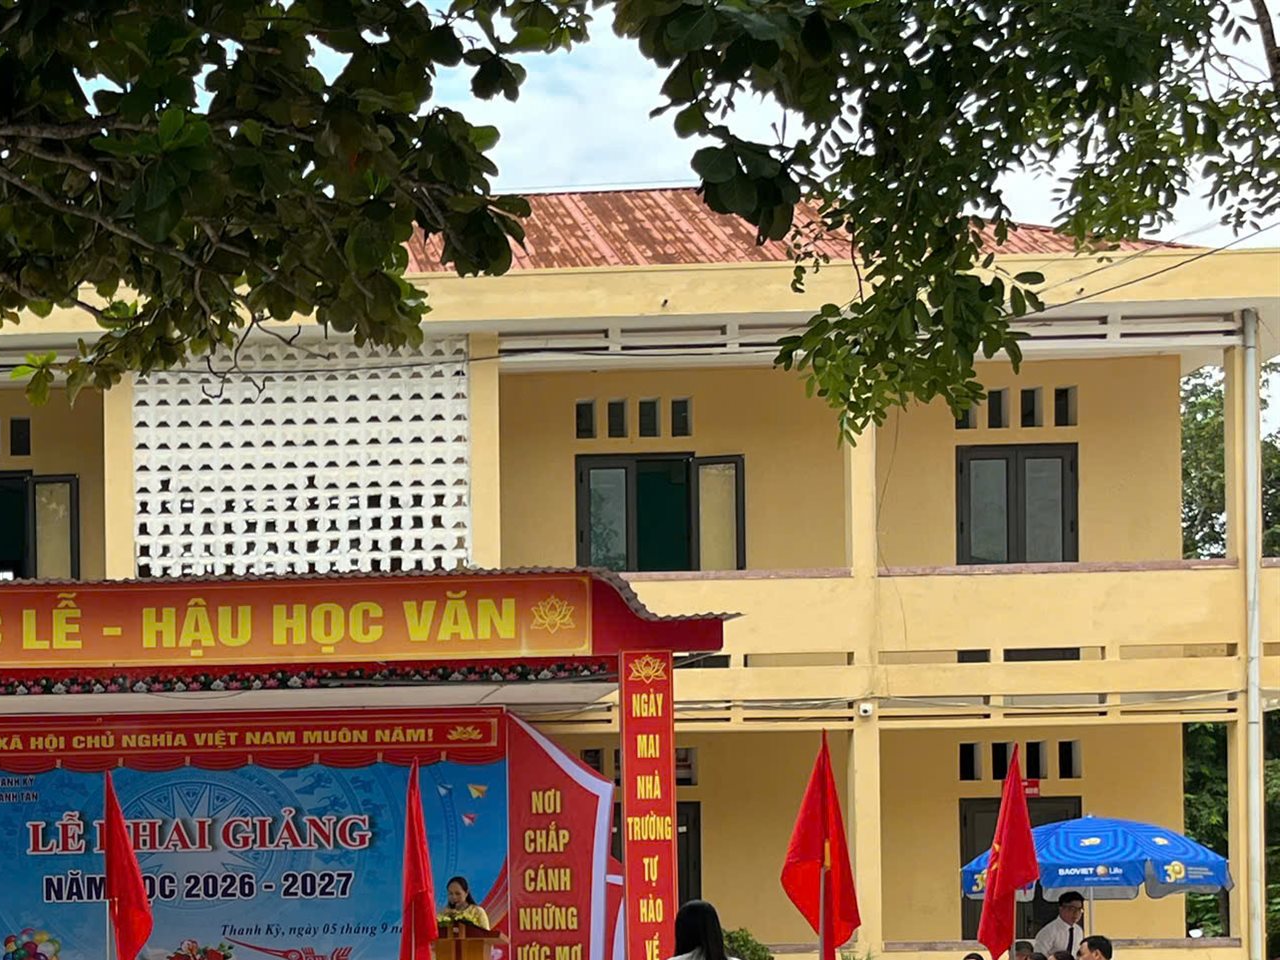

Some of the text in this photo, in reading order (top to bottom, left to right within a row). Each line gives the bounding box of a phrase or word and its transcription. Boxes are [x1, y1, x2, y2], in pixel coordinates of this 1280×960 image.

[22, 592, 83, 650] LỄ
[102, 626, 122, 636] -
[142, 597, 252, 657] HẬU
[272, 601, 384, 654] HỌC
[402, 590, 516, 642] VĂN
[632, 688, 663, 718] NGÀY
[30, 733, 66, 753] HỘI
[72, 730, 115, 749] CHỦ
[121, 730, 187, 748] NGHĨA
[194, 729, 239, 750] VIỆT
[245, 730, 296, 746] NAM
[302, 727, 368, 744] MUÔN
[374, 726, 434, 743] NĂM!
[636, 734, 660, 759] MAI
[636, 770, 662, 800] NHÀ
[531, 789, 561, 814] NƠI
[26, 811, 86, 855] LỄ
[221, 807, 372, 851] GIẢNG
[524, 821, 570, 853] CHẮP
[627, 811, 672, 842] TRƯỜNG
[184, 871, 256, 900] 2026
[281, 870, 355, 900] 2027
[524, 864, 571, 892] CÁNH
[643, 855, 659, 887] TỰ
[519, 903, 579, 930] NHỮNG
[639, 894, 664, 924] HÀO
[221, 924, 261, 936] Thanh
[288, 923, 319, 938] ngày
[322, 923, 338, 935] 05
[340, 922, 378, 937] tháng
[380, 921, 388, 934] 9
